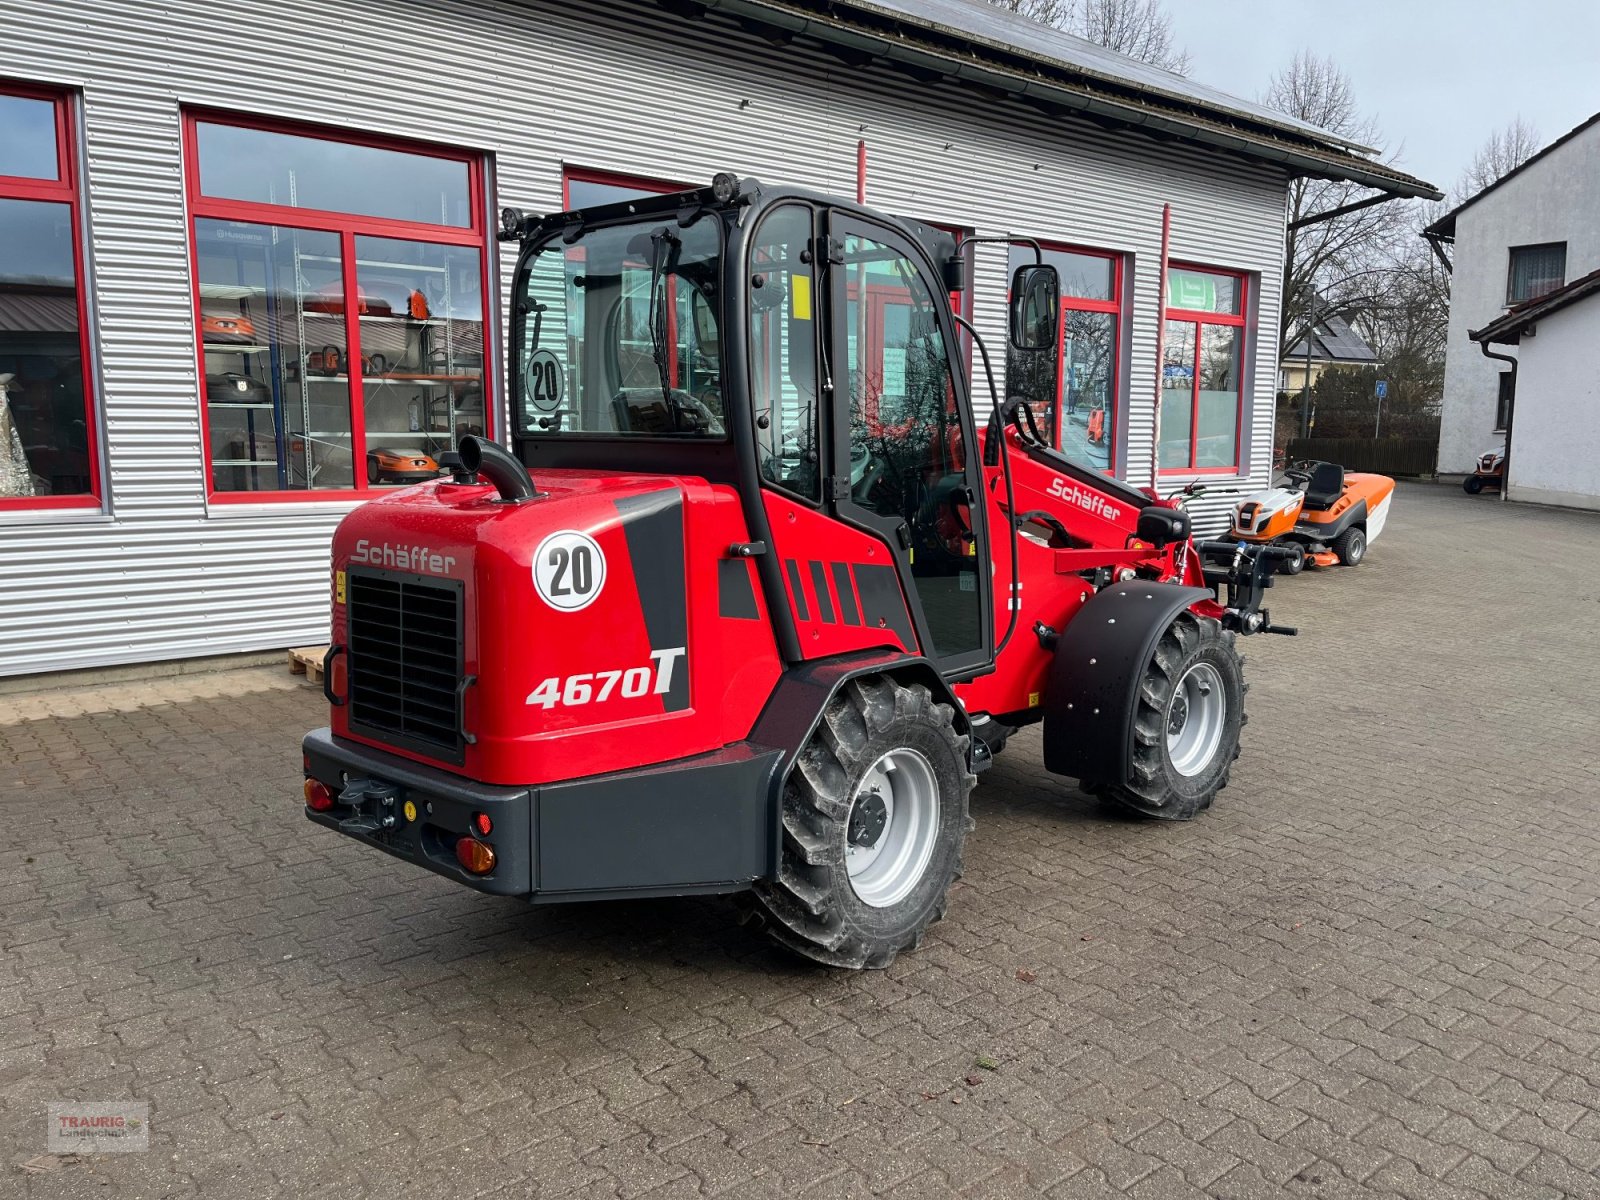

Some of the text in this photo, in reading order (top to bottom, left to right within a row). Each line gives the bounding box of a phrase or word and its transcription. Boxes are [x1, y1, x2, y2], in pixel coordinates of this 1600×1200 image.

[532, 360, 558, 401] 20
[1046, 477, 1121, 521] Schäffer
[350, 539, 456, 574] Schäffer
[548, 545, 593, 596] 20
